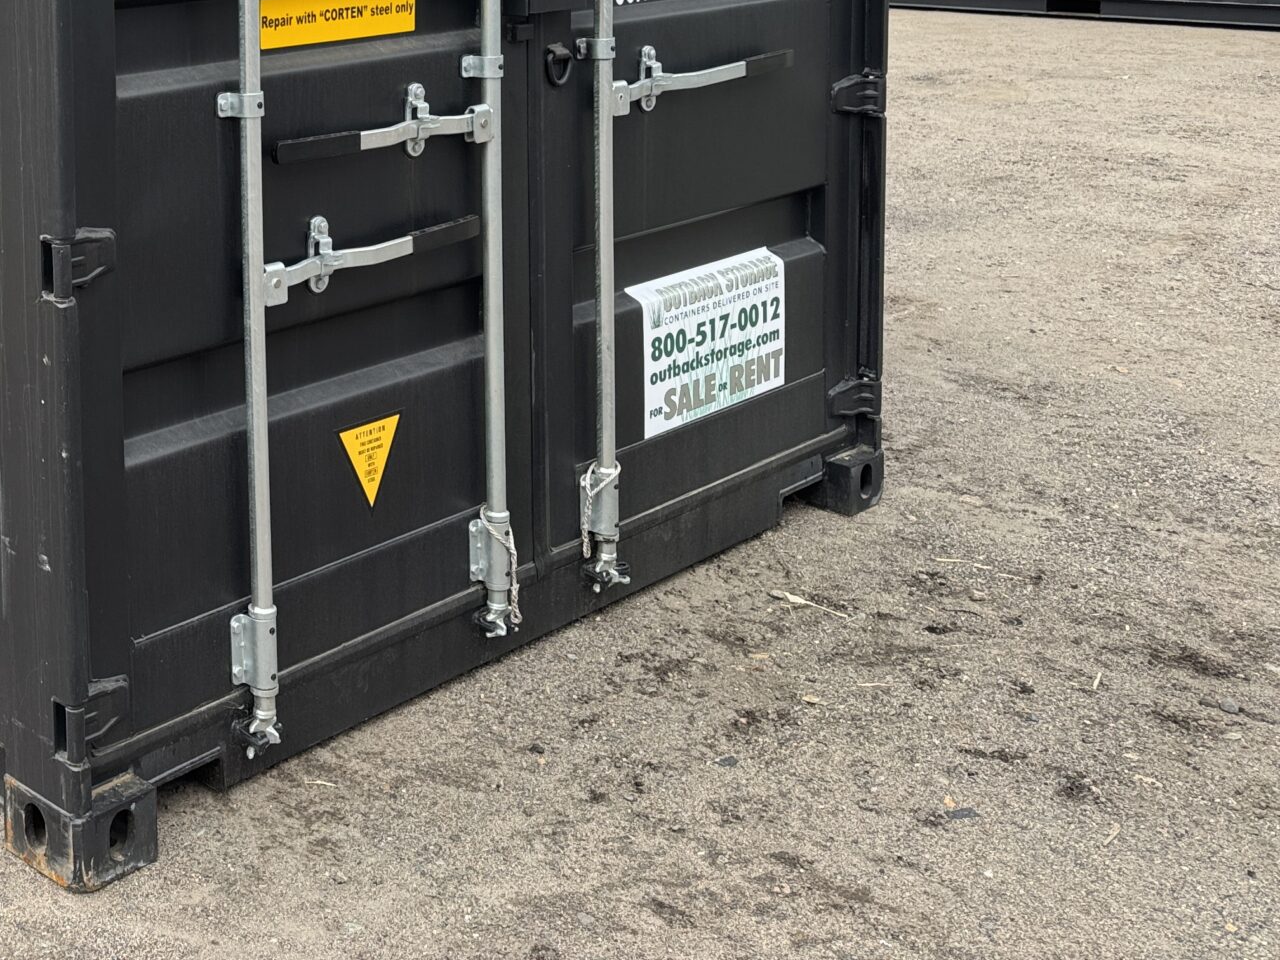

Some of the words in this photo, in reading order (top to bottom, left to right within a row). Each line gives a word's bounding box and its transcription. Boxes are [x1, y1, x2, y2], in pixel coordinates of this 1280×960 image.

[261, 13, 293, 31] Repair
[296, 11, 317, 26] with
[370, 2, 393, 17] steel
[395, 0, 414, 16] only
[655, 271, 723, 313] OUTBACK
[716, 254, 779, 294] STORAGE
[664, 303, 710, 326] CONTAINERS
[712, 291, 751, 310] DELIVERED
[752, 286, 763, 297] ON
[764, 281, 779, 293] SITE
[649, 327, 780, 386] outbackstorage.com
[650, 296, 781, 362] 800-517-0012
[649, 406, 663, 419] FOR
[663, 372, 717, 421] SALE
[718, 382, 728, 393] OR
[729, 347, 784, 396] RENT
